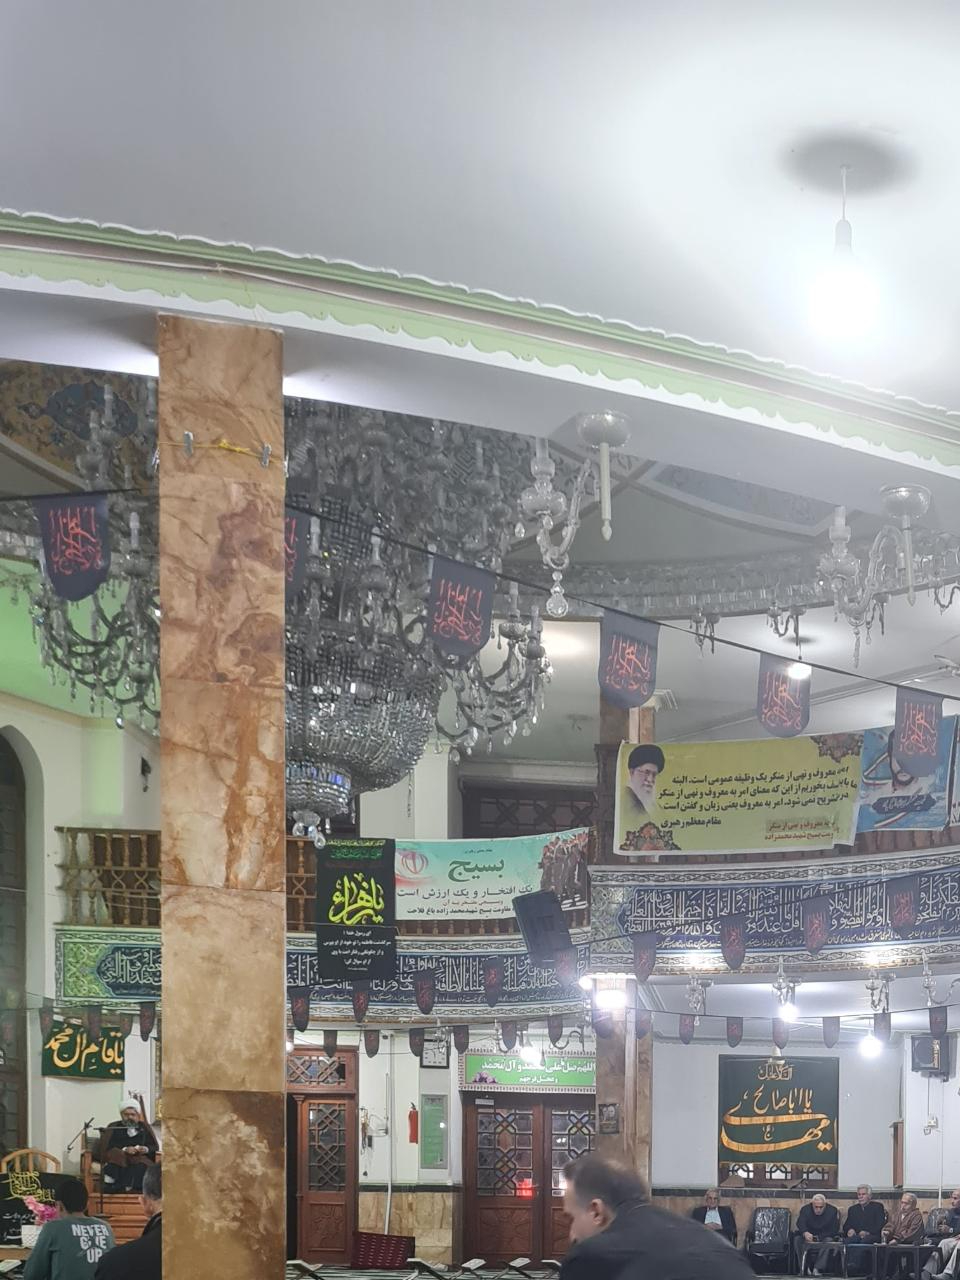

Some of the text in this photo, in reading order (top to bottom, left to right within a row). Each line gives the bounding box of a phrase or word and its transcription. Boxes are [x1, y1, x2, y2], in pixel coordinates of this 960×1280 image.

[672, 775, 688, 786] البته
[708, 775, 733, 785] عمومی
[733, 773, 755, 784] وظیفه
[705, 787, 728, 798] معروف
[704, 800, 720, 811] زبان
[739, 799, 763, 810] معروف
[660, 816, 721, 829] مقام معظم رهبری
[447, 859, 505, 882] بسیج
[397, 888, 419, 897] است
[422, 888, 450, 900] ارزش
[453, 888, 470, 899] یک
[481, 885, 516, 898] افتخار
[518, 885, 533, 895] یک
[71, 1224, 110, 1237] NEVER
[87, 1248, 103, 1263] UP
